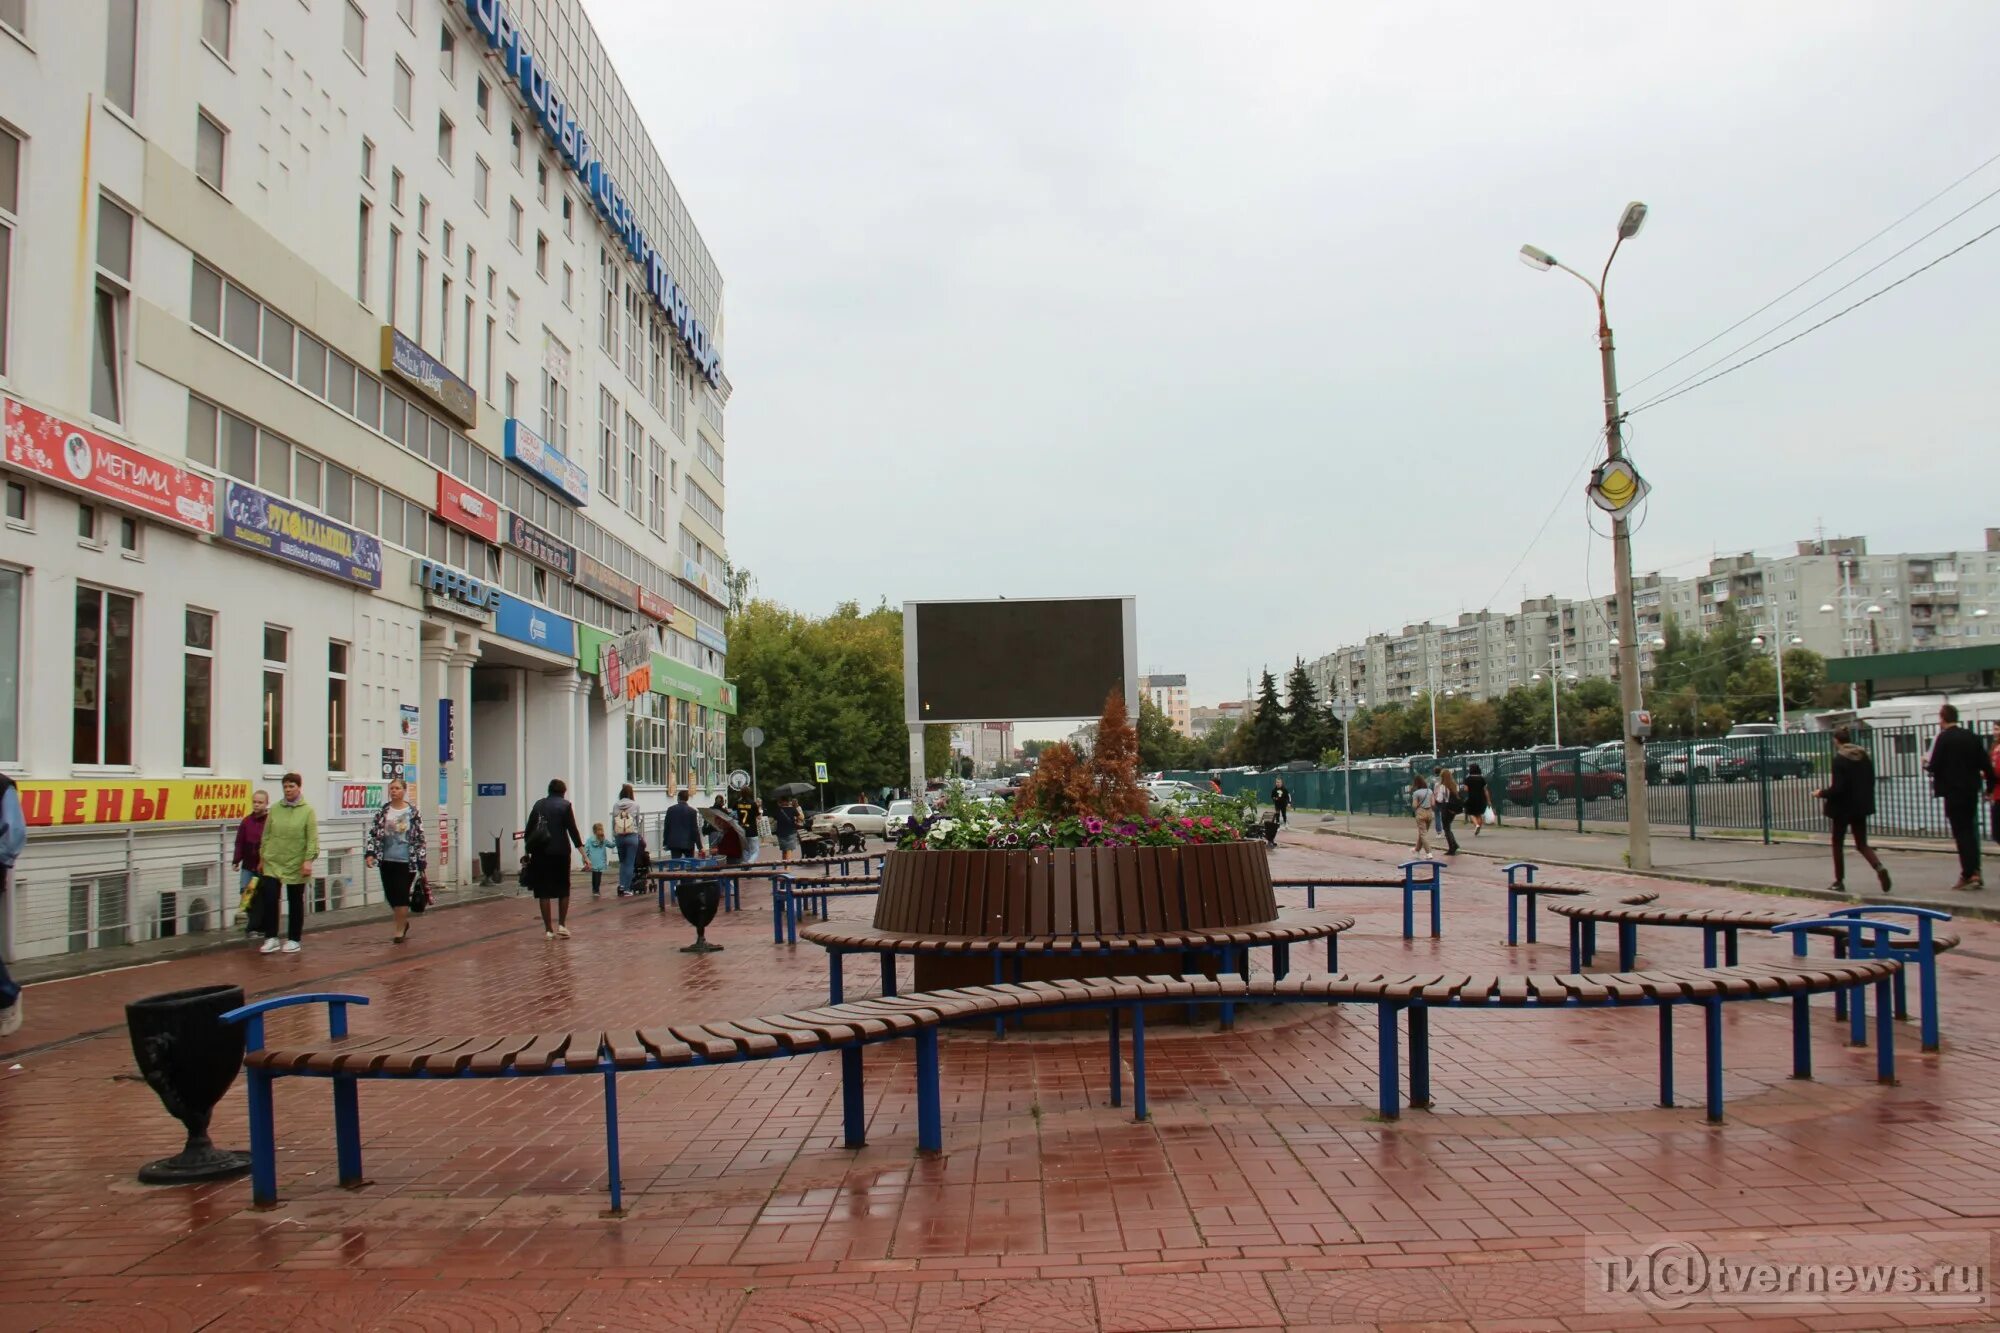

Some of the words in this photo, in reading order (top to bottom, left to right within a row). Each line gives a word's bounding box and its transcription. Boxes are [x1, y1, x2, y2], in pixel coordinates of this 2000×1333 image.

[648, 250, 721, 389] ПАРАДИЗ
[96, 448, 171, 496] МЕГУМИ
[21, 788, 169, 826] ЦЕНЫ
[193, 783, 247, 799] МАГАЗИН
[194, 803, 246, 820] ОДЕЖДЫ
